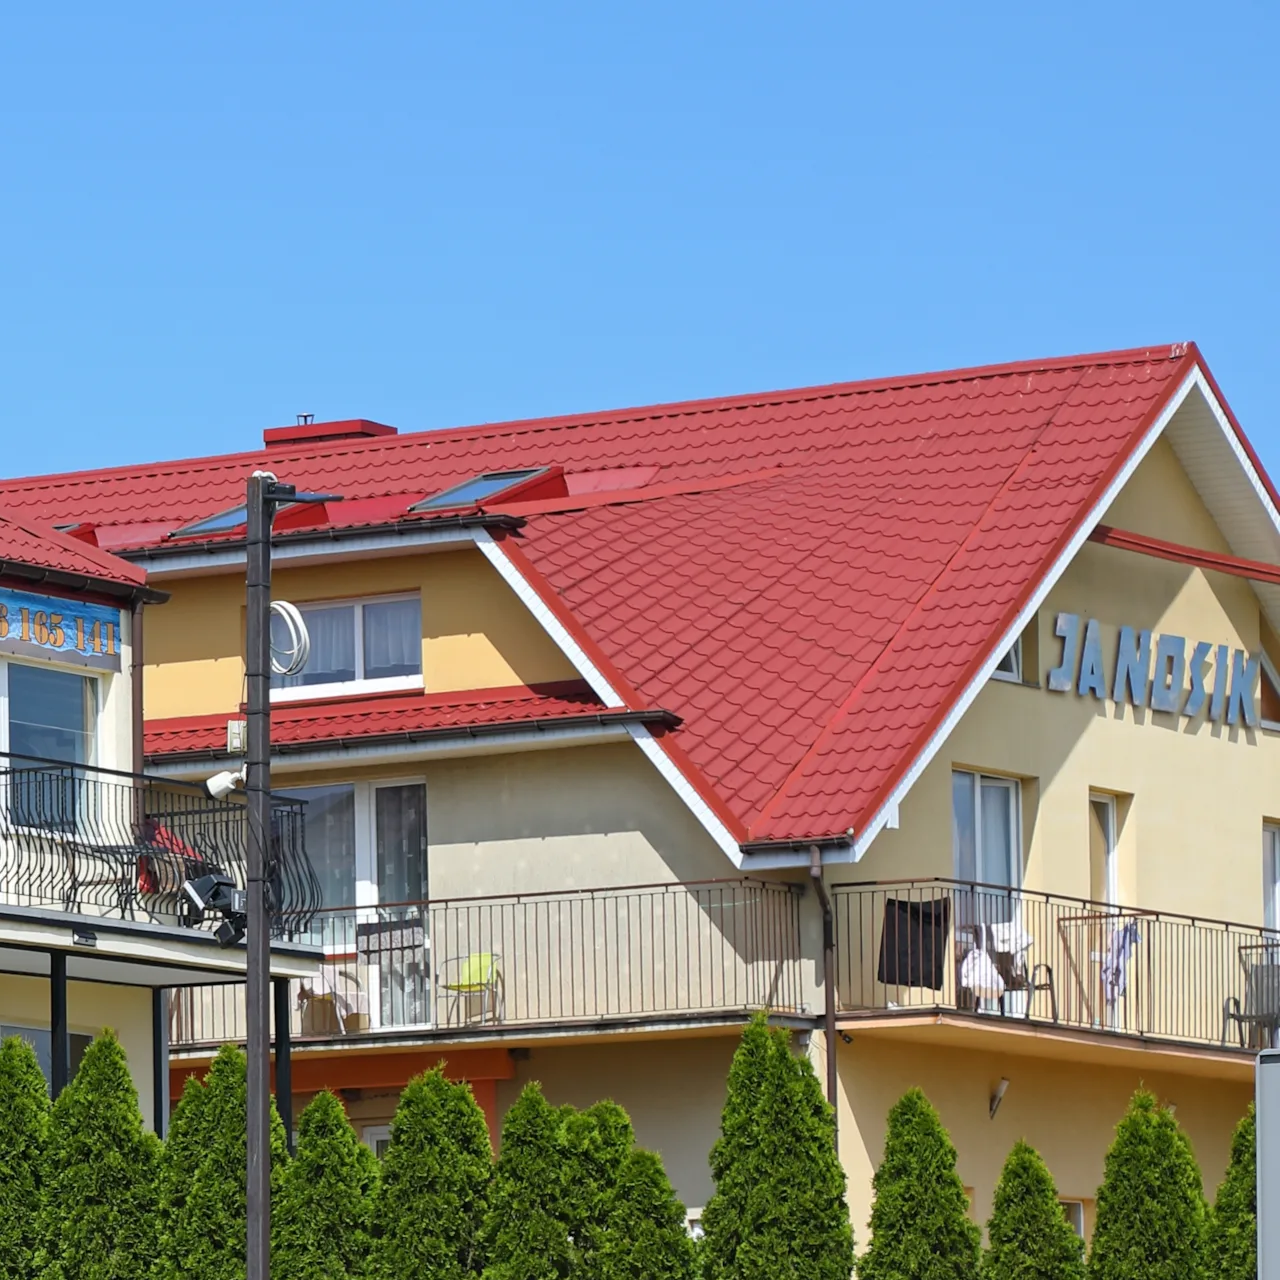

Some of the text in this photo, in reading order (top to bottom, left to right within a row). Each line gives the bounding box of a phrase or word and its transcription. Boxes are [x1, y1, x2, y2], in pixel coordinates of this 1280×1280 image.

[20, 608, 64, 648] 165
[76, 618, 117, 655] 141
[1048, 612, 1259, 727] JANOSIK
